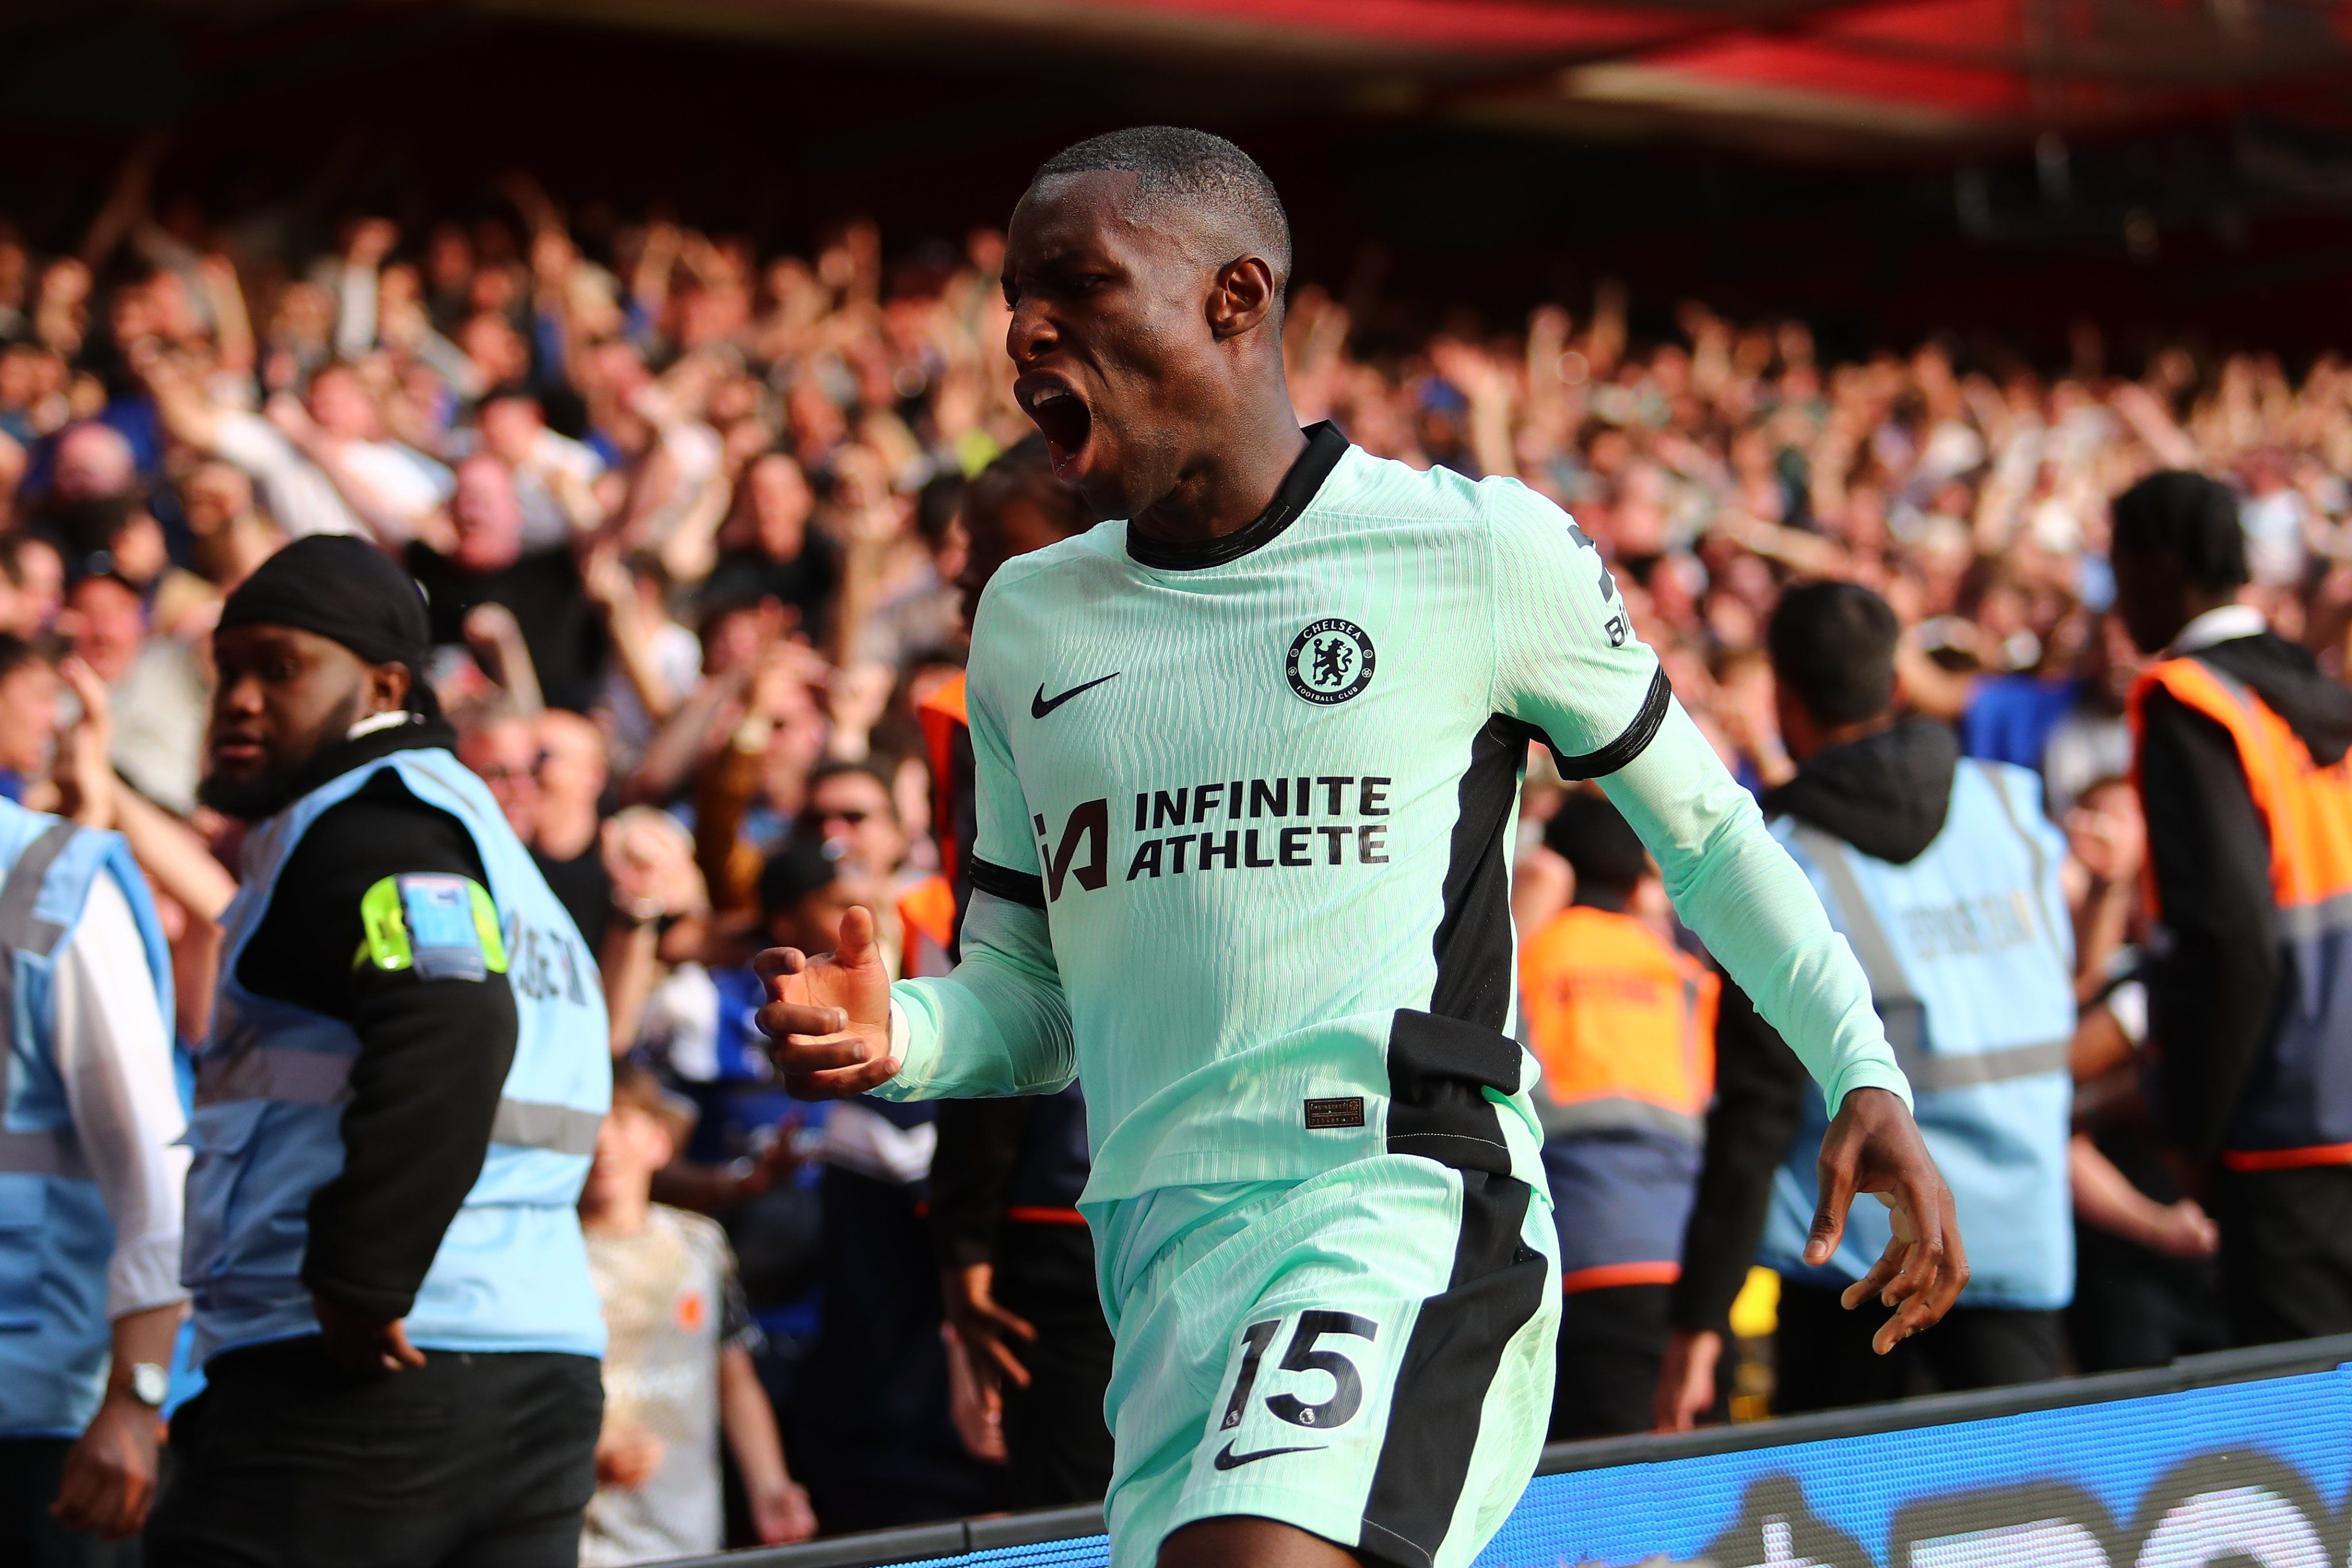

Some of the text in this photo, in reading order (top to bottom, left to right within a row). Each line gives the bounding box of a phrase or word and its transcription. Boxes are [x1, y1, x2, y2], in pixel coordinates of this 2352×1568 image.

[1303, 621, 1361, 640] CHELSEA
[1297, 685, 1358, 702] FOOTBALL CLUB
[1135, 777, 1391, 831] INFINITE
[1126, 825, 1389, 881] ATHLETE
[1220, 1310, 1379, 1431] 15
